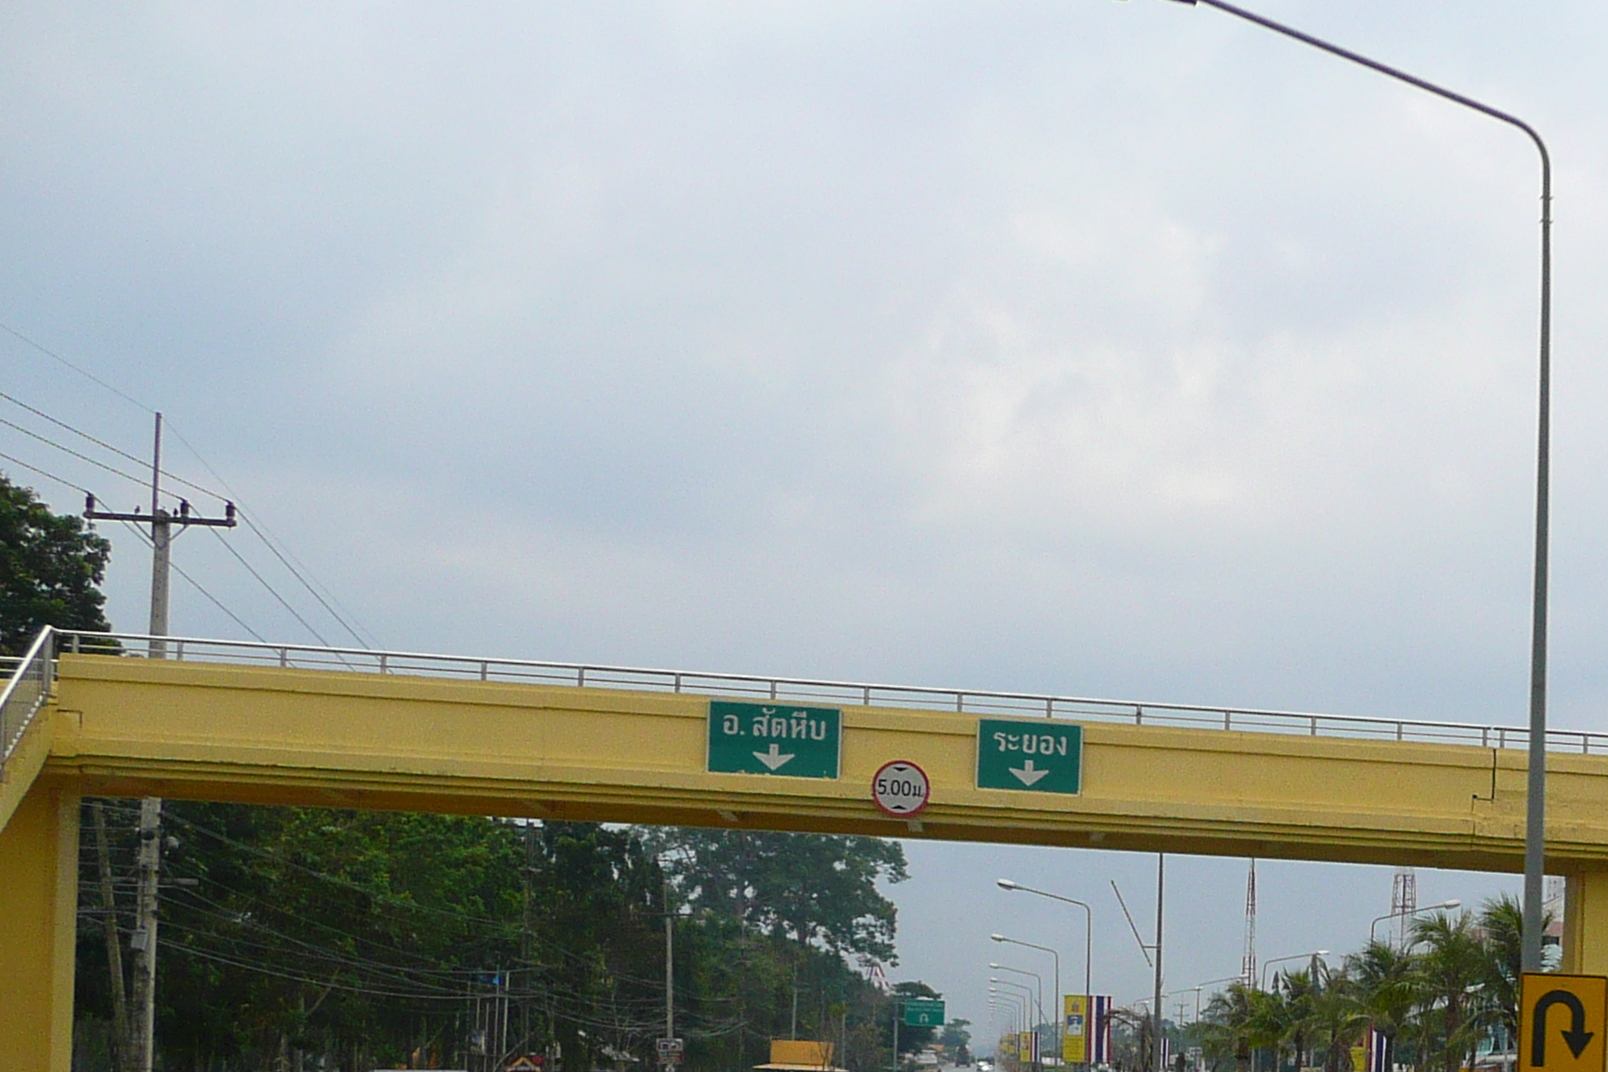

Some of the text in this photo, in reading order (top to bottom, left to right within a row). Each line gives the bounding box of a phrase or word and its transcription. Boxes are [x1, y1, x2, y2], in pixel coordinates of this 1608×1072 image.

[723, 707, 826, 740] อ. สัตหีบ
[994, 732, 1067, 756] ระยอง
